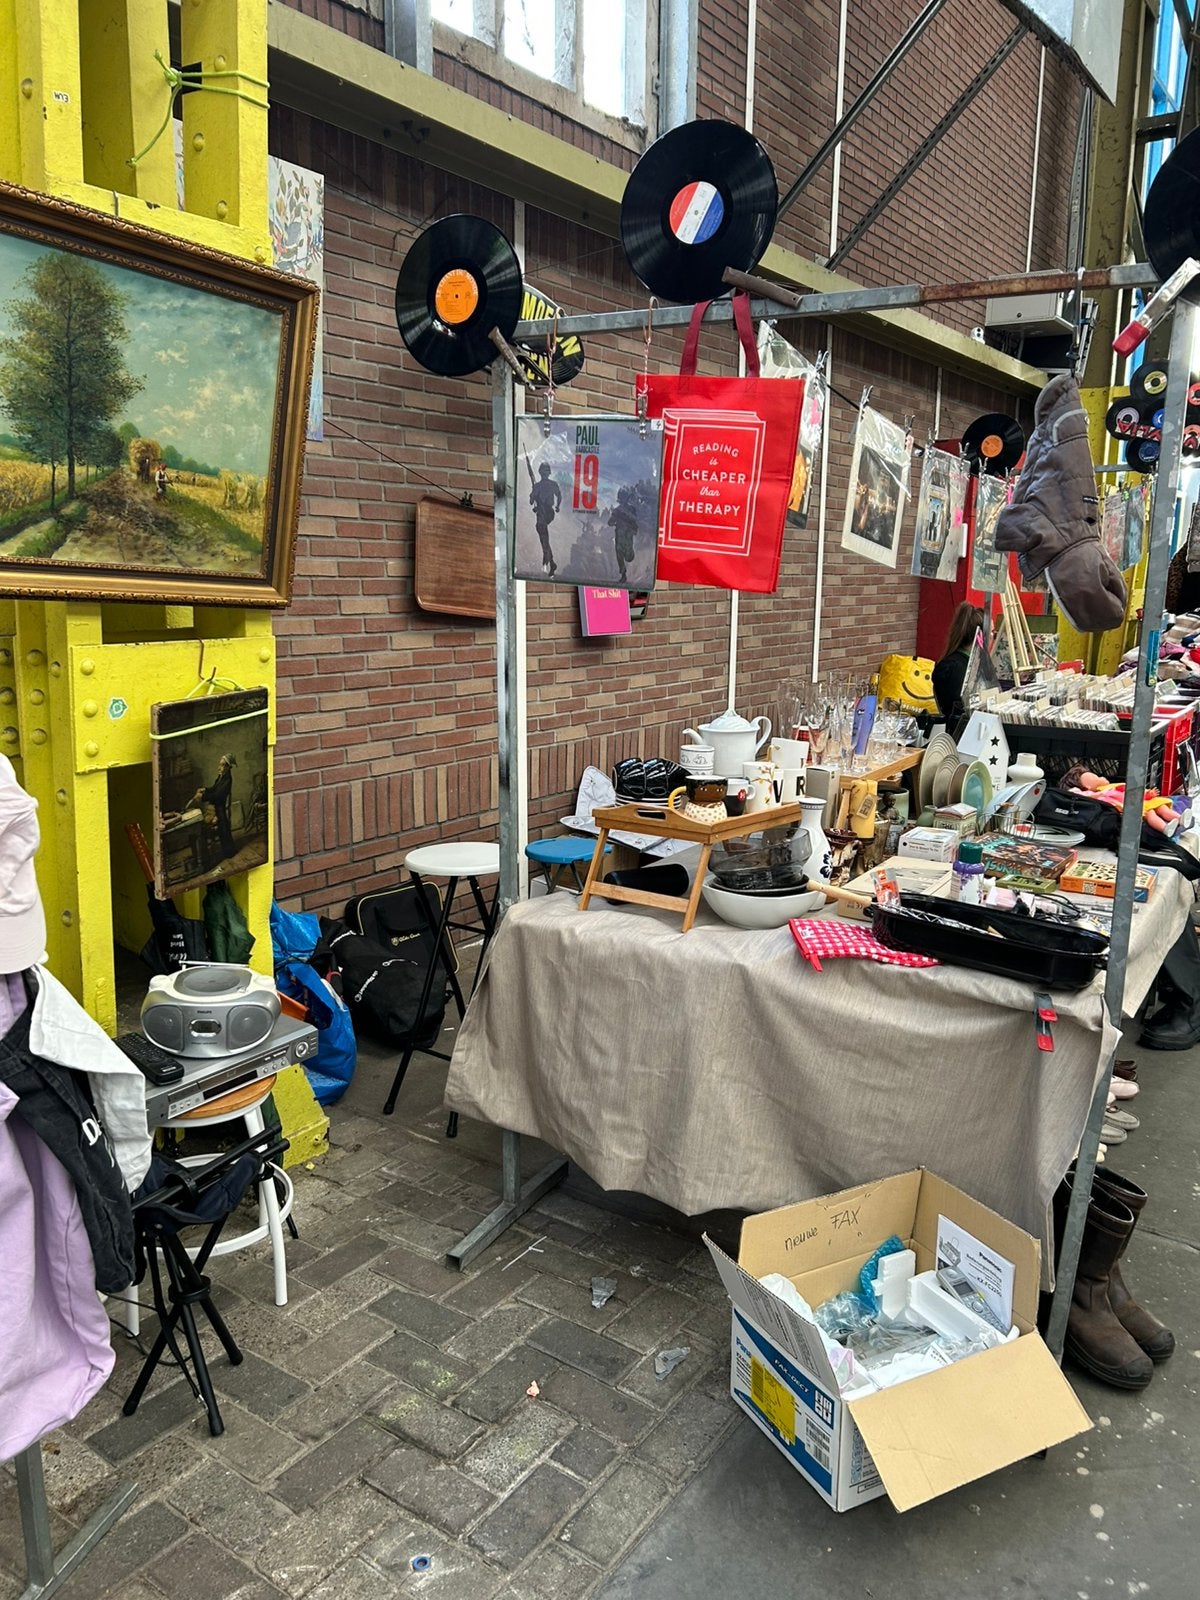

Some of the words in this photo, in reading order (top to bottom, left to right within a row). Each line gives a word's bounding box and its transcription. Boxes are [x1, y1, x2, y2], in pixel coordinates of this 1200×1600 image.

[575, 425, 600, 446] PAUL
[692, 442, 740, 458] READING
[709, 457, 719, 466] is
[572, 453, 600, 510] 19
[682, 469, 746, 485] CHEAPER
[700, 486, 721, 497] than
[679, 500, 740, 517] THERAPY
[591, 588, 608, 599] That
[608, 588, 622, 598] Shit
[830, 1206, 861, 1229] FAX
